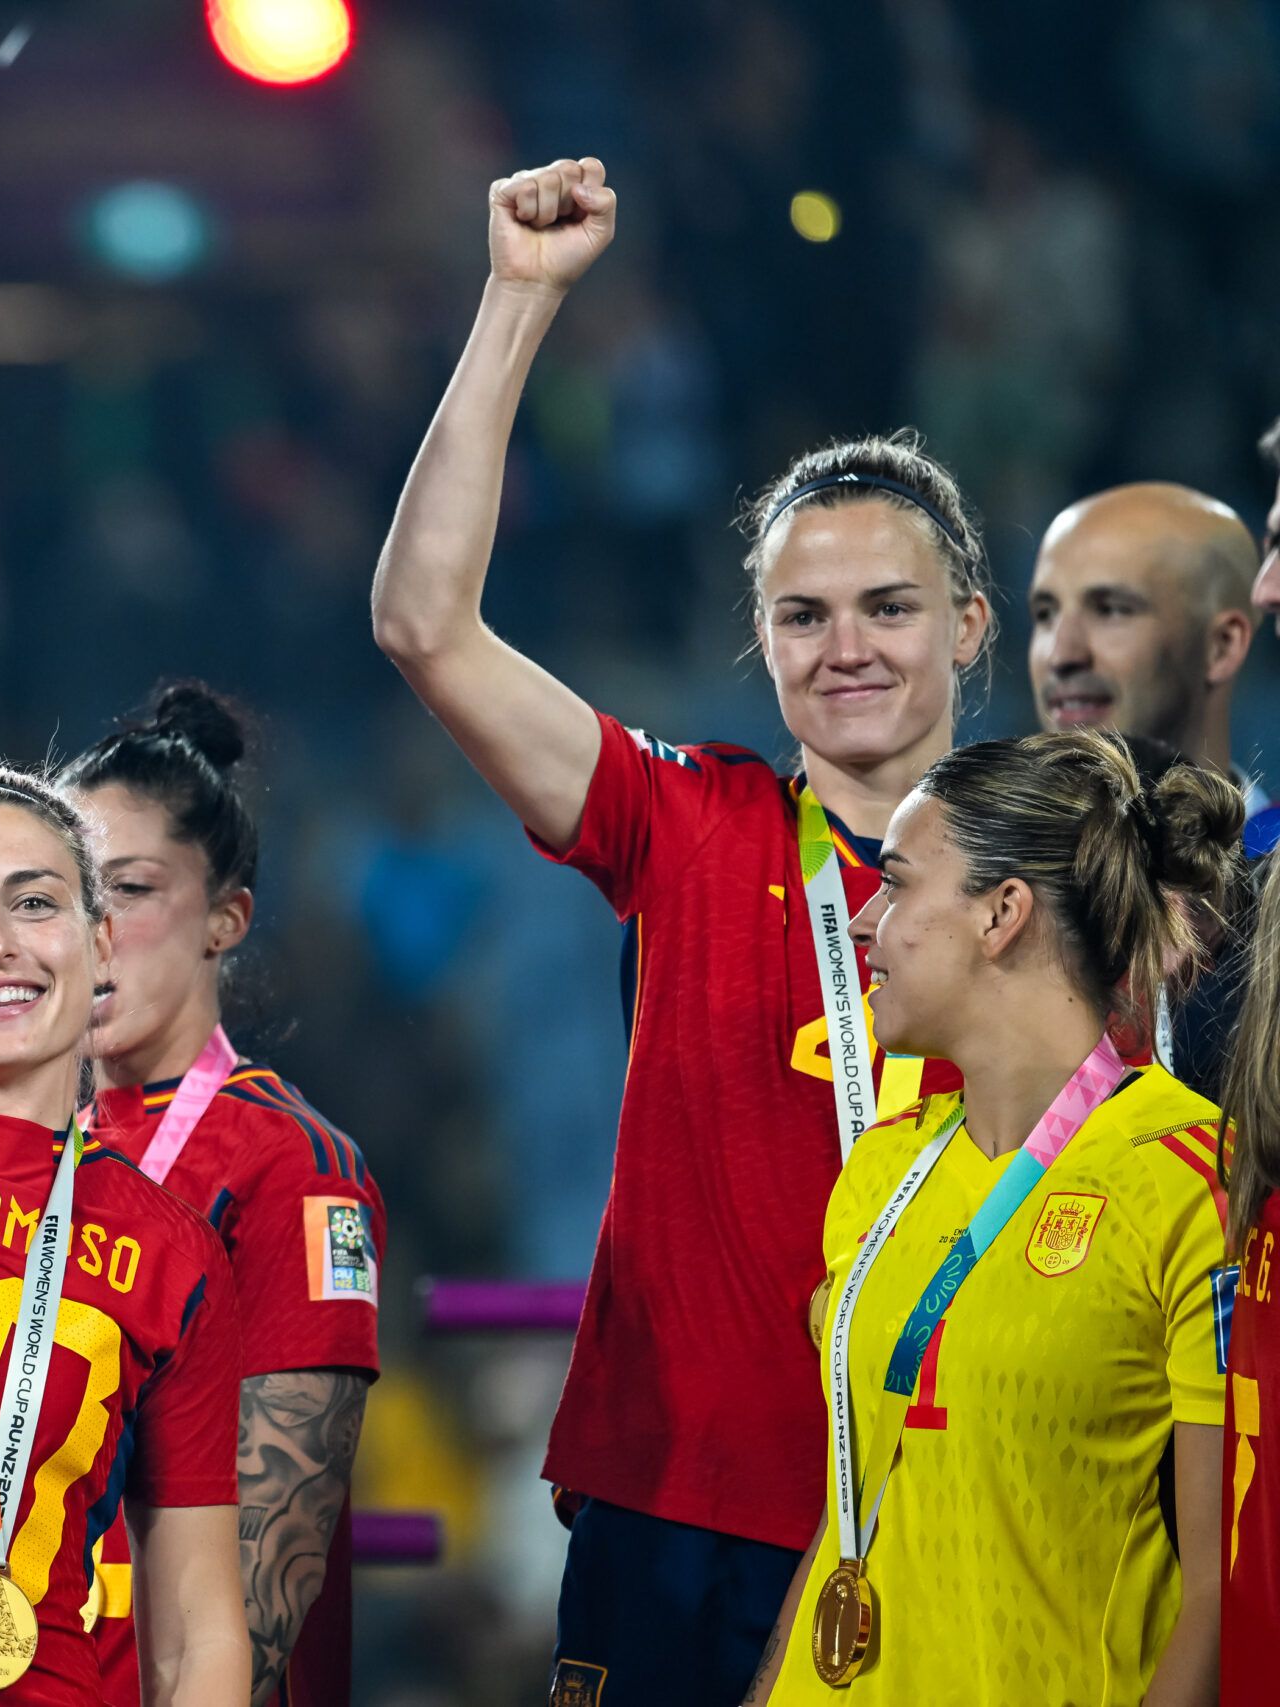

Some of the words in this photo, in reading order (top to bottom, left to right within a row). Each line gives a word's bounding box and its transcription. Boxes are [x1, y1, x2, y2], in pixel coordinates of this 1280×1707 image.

[821, 903, 838, 935] FIFA
[826, 935, 851, 1012] WOMEN'S
[838, 1014, 858, 1078] WORLD
[846, 1081, 863, 1117] CUP
[894, 1171, 920, 1204] FIFA
[43, 1215, 59, 1245] FIFA
[851, 1204, 900, 1281] WOMEN'S
[32, 1246, 56, 1318] WOMEN'S
[334, 1268, 353, 1279] AU
[335, 1279, 353, 1289] NZ
[835, 1284, 857, 1348] WORLD
[20, 1319, 42, 1374] WORLD
[834, 1351, 843, 1389] CUP
[18, 1377, 33, 1413] CUP
